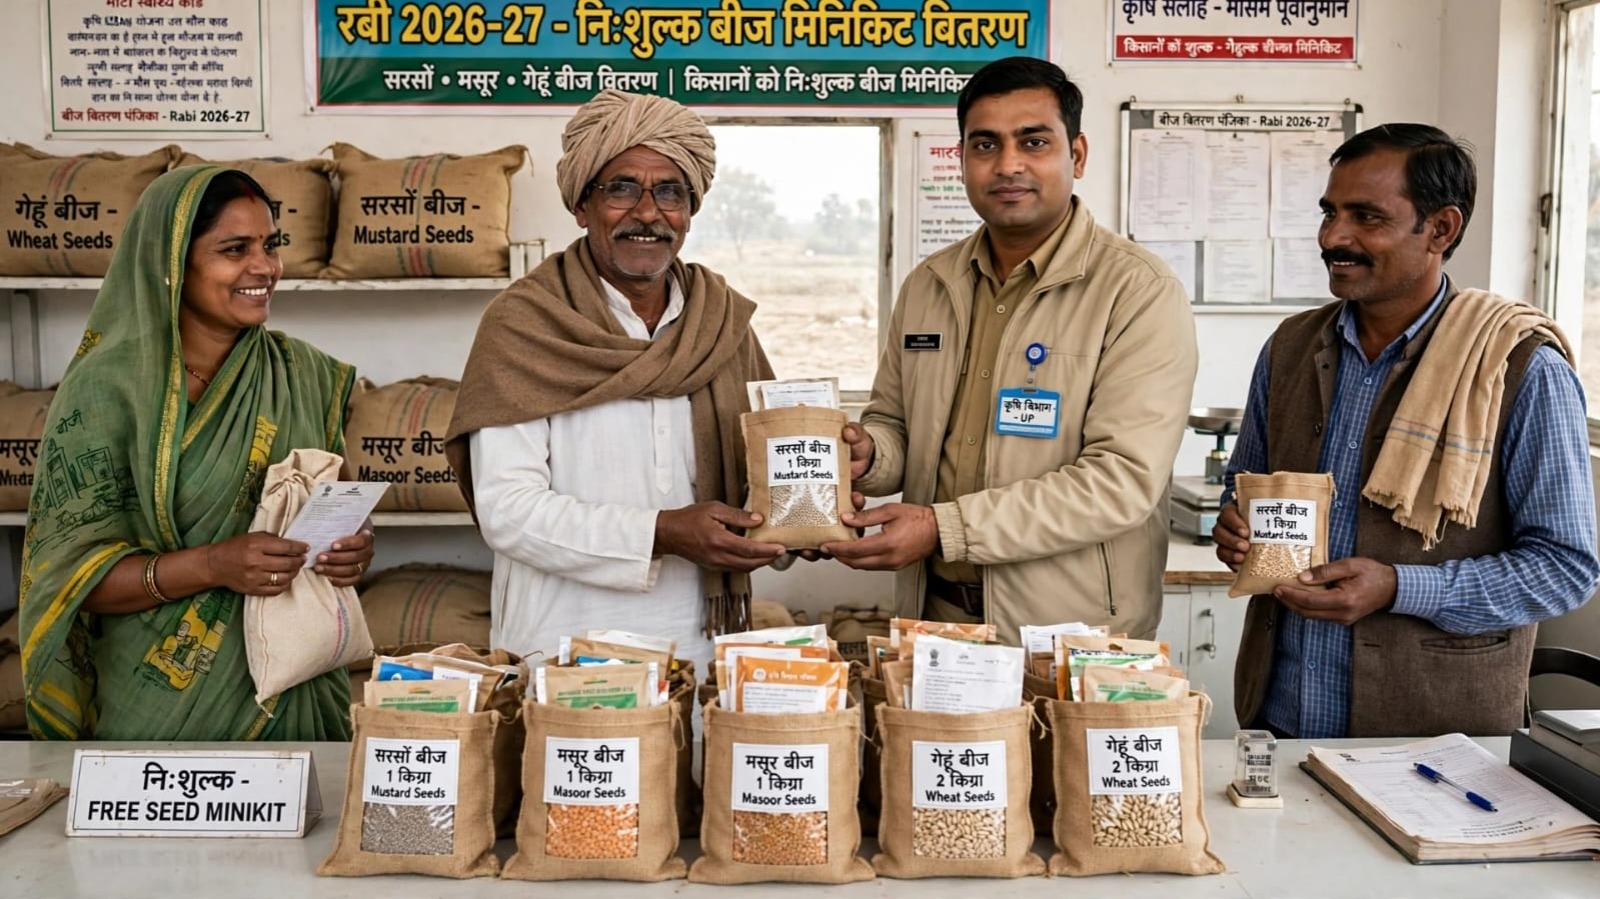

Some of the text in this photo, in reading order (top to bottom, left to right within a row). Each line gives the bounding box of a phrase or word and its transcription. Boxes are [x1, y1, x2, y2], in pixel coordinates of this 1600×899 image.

[1162, 0, 1208, 19] सलाह
[336, 0, 393, 43] रबी
[400, 3, 545, 44] 2026-27
[708, 0, 776, 45] बीज
[782, 0, 917, 47] मिनिकिट
[383, 63, 434, 90] सरसों
[457, 69, 500, 97] मसूर
[555, 67, 593, 90] बीज
[684, 66, 752, 92] किसानों
[755, 66, 780, 92] को
[859, 67, 897, 93] बीज
[901, 67, 975, 93] मिनिकि
[61, 107, 83, 122] बीज
[125, 107, 159, 122] पंजिका
[170, 110, 196, 122] Rabi
[200, 110, 250, 122] 2026-27
[1159, 111, 1180, 126] बीज
[1218, 112, 1250, 127] पंजिका
[1260, 115, 1283, 127] Rabi
[1286, 116, 1330, 128] 2026-27
[54, 194, 101, 221] बीज
[360, 188, 417, 216] सरसों
[423, 188, 467, 216] बीज
[7, 229, 113, 250] Wheat Seeds
[353, 224, 474, 245] Mustard Seeds
[1020, 412, 1035, 423] UP
[0, 439, 41, 466] मसूर
[361, 436, 406, 464] मसूर
[774, 440, 831, 456] सरसों बीज
[796, 455, 821, 468] किग्रा
[357, 465, 457, 484] Masoor Seeds
[774, 470, 833, 480] Mustard Seeds
[1256, 502, 1308, 517] सरसों बीज
[1274, 516, 1297, 530] किग्रा
[1285, 531, 1308, 541] Seeds
[1133, 734, 1162, 753] बीज
[375, 745, 447, 764] सरसों बीज
[557, 744, 625, 769] मसूर बीज
[745, 750, 814, 775] मसूर बीज
[959, 748, 989, 767] बीज
[1112, 756, 1159, 774] 2 किग्रा
[386, 766, 432, 785] 1 किग्रा
[567, 766, 613, 785] 1 किग्रा
[757, 773, 804, 791] 1 किग्रा
[936, 769, 984, 788] 2 किग्रा
[1101, 775, 1171, 789] Wheat Seeds
[371, 785, 446, 799] Mustard Seeds
[553, 785, 626, 799] Masoor Seeds
[742, 792, 816, 806] Masoor Seeds
[925, 790, 995, 803] Wheat Seeds
[87, 800, 286, 823] FREE SEED MINIKIT
